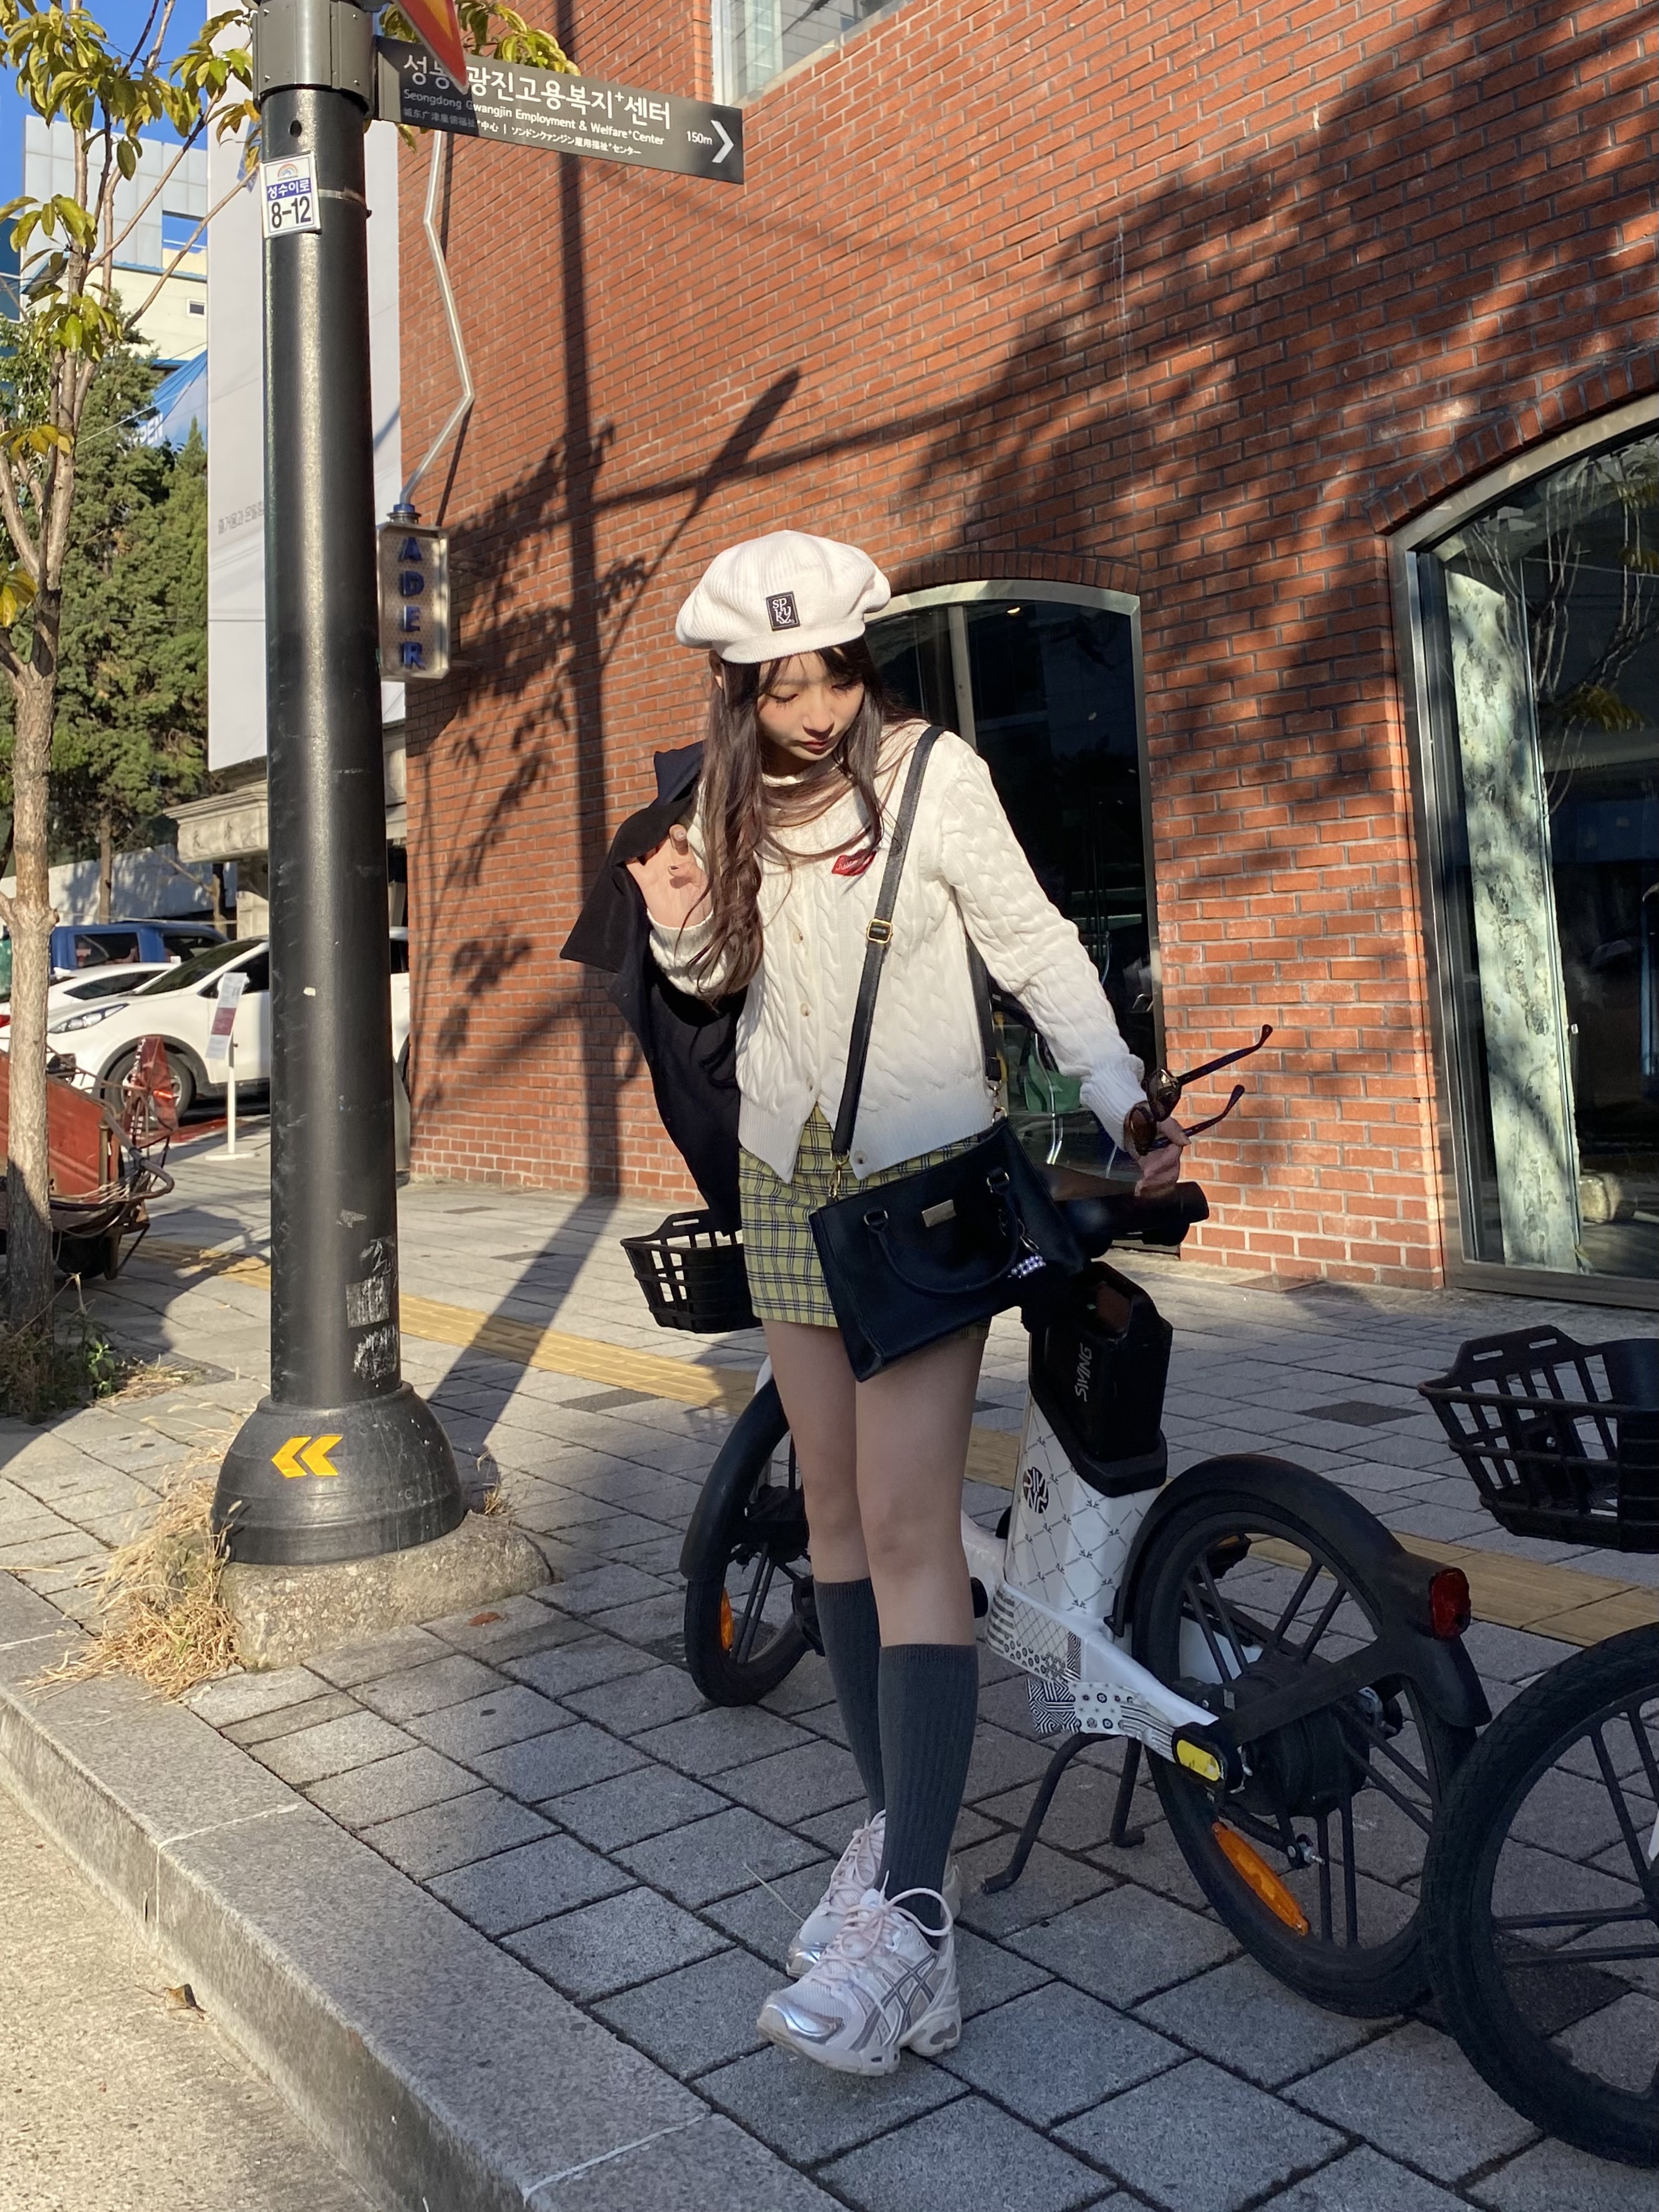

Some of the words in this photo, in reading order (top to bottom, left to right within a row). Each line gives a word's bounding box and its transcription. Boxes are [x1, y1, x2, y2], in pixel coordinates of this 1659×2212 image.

[403, 89, 462, 110] Seongdong
[466, 100, 512, 119] Gwangjin
[515, 108, 576, 129] Employment
[578, 120, 588, 132] &
[686, 130, 713, 146] 150m
[267, 179, 310, 199] 성수이로
[271, 195, 311, 228] 8-12
[398, 536, 427, 670] ADER
